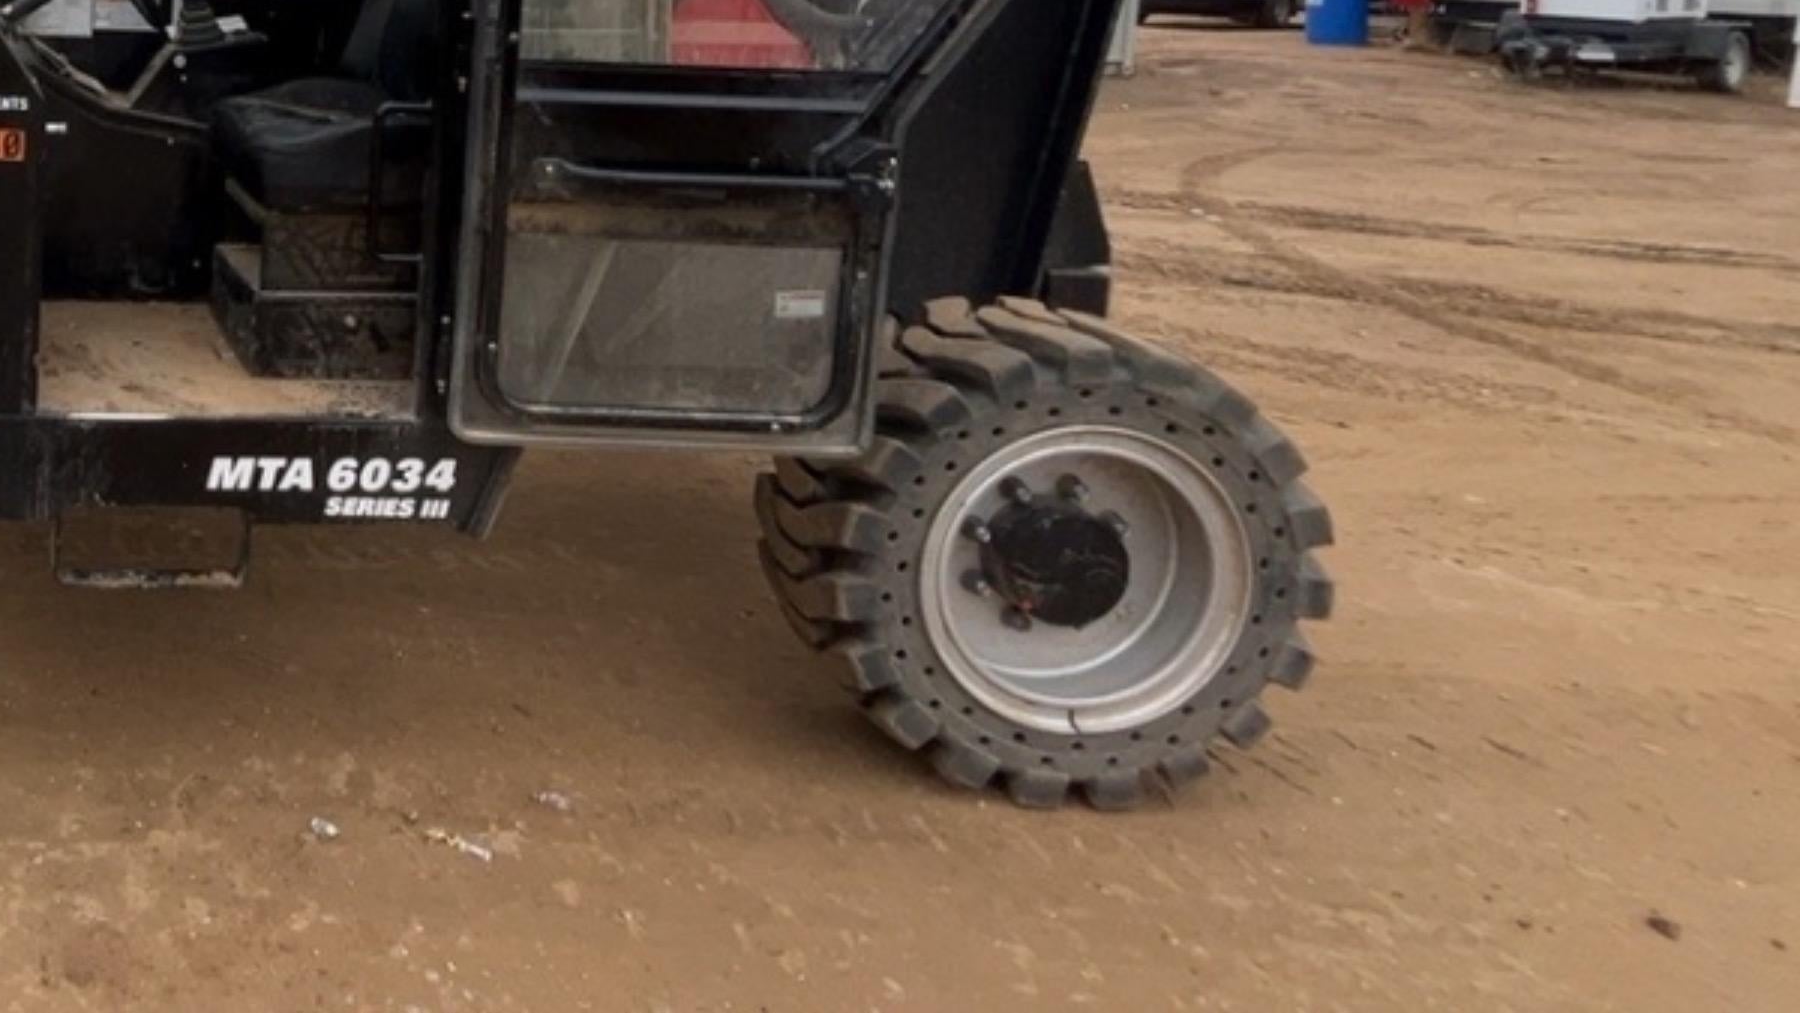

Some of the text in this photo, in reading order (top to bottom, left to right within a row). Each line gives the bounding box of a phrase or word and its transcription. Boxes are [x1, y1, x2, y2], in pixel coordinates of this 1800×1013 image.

[206, 456, 458, 492] MTA 6034
[323, 496, 416, 518] SERIES
